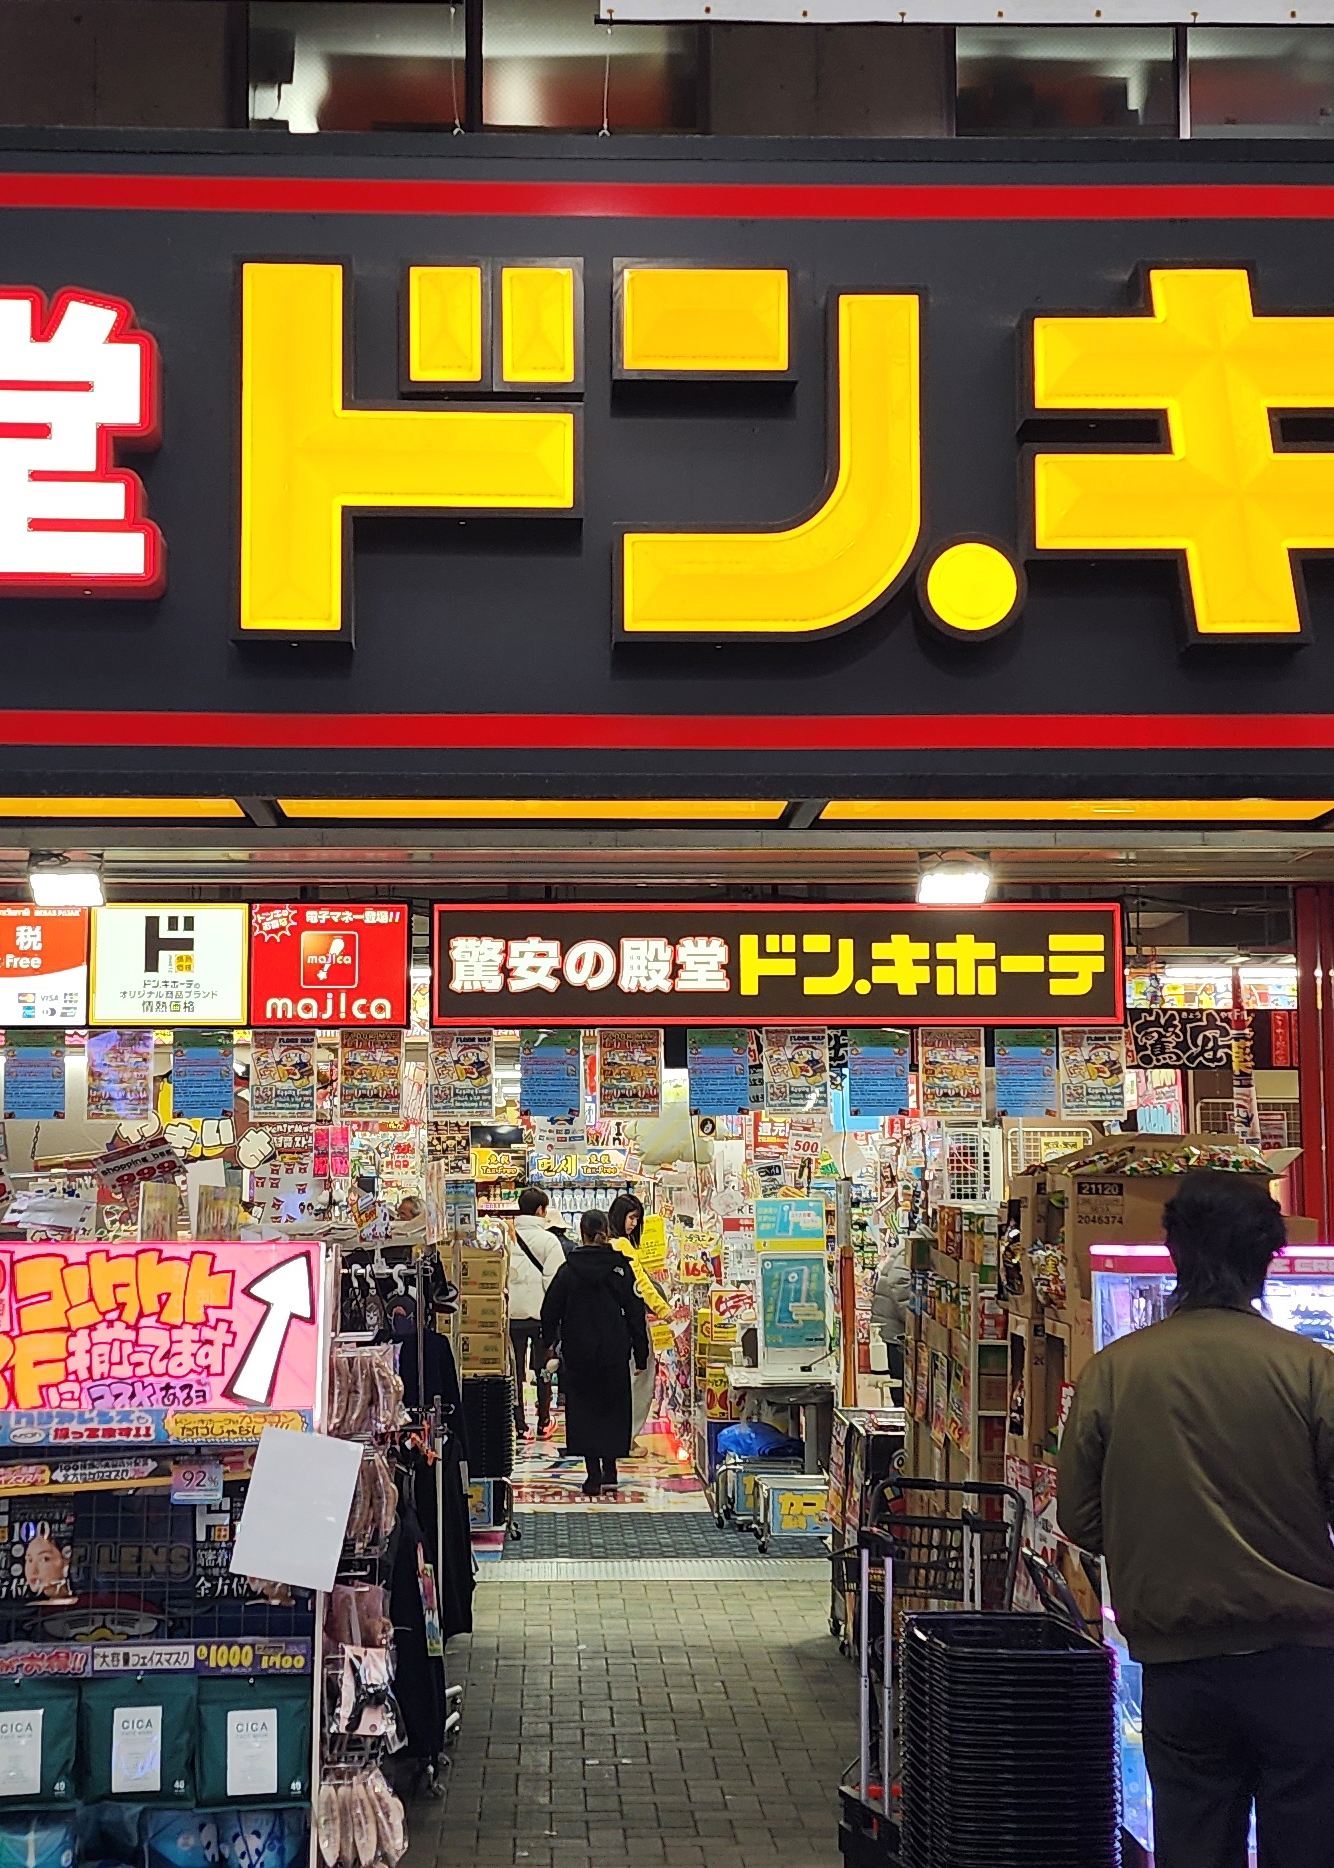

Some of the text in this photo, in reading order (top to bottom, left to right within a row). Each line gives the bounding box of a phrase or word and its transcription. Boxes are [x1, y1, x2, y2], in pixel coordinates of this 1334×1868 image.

[144, 916, 195, 973] ド
[5, 954, 42, 969] Free
[448, 936, 731, 993] 驚安の殿堂
[120, 990, 218, 999] オリジナル商品ブランド
[142, 1000, 195, 1013] 情熱価格
[794, 1140, 819, 1153] 500
[101, 1149, 173, 1176] shopping bag
[536, 1154, 578, 1177] 면세
[1081, 1183, 1119, 1194] 21120
[1077, 1215, 1123, 1225] 2046374
[182, 1470, 219, 1488] 92%
[12, 1521, 51, 1543] 100
[97, 1544, 192, 1574] LENS
[99, 1651, 190, 1668] 大容量フェイスマスク
[0, 1721, 33, 1733] CICA
[122, 1719, 153, 1731] CICA
[235, 1722, 268, 1733] CICA
